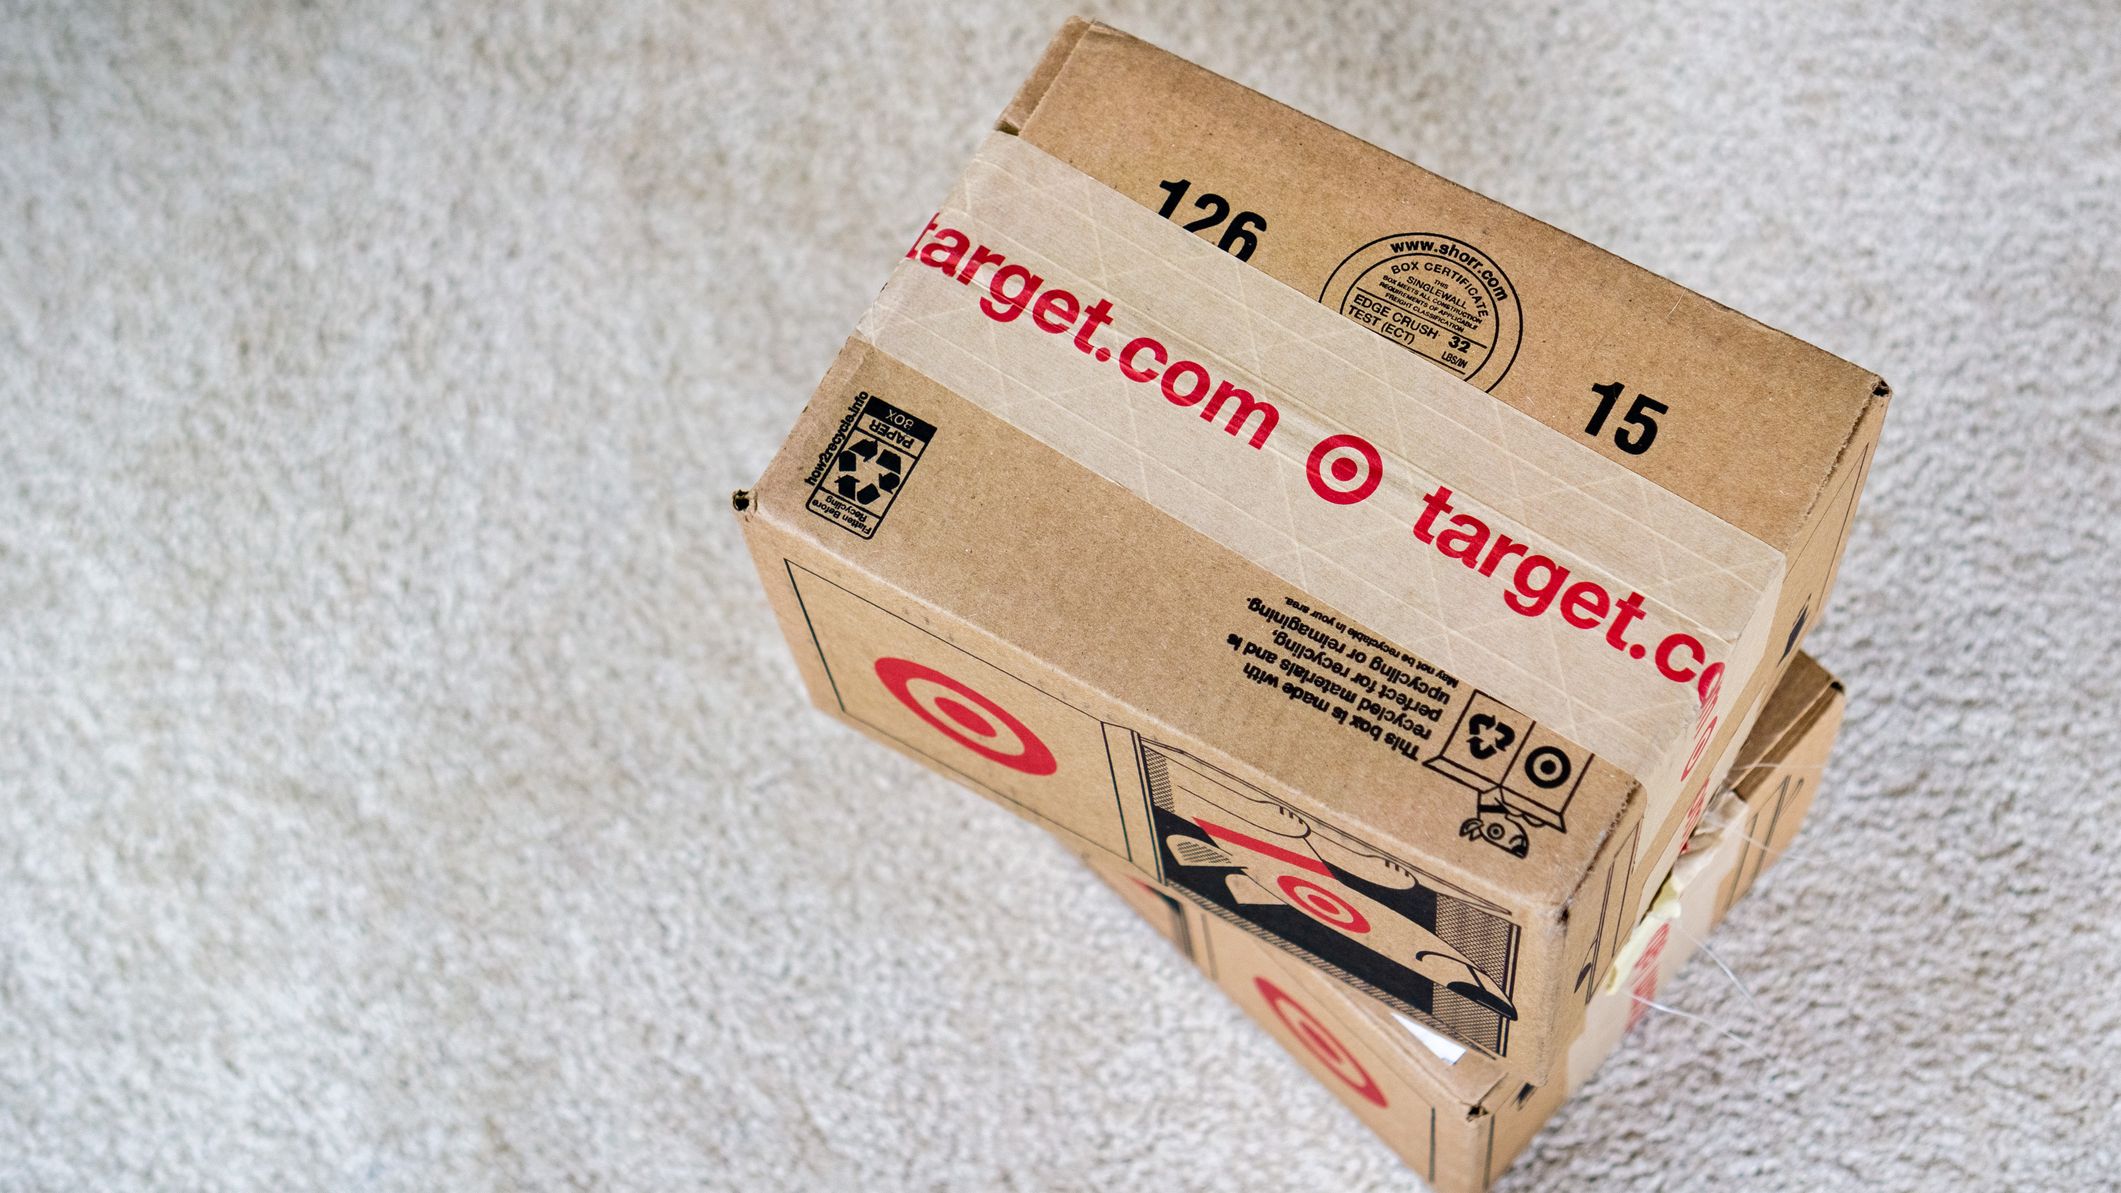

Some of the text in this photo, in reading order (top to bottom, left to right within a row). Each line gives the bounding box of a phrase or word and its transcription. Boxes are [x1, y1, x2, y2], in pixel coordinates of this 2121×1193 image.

[1158, 179, 1267, 262] 126
[1390, 240, 1508, 302] www.shorr.com
[1391, 261, 1489, 318] BOX CERTIFICATE
[1406, 276, 1467, 310] SINGLEWALL
[1434, 279, 1449, 289] THIS
[1353, 294, 1439, 340] EDGE CRUSH
[1379, 282, 1478, 331] REQUIREMENTS OF APPLICABLE
[1382, 275, 1483, 324] BOX MEETS ALL CONSTRUCTION
[1385, 292, 1465, 333] FREIGHT CLASSIFICATION
[1348, 304, 1415, 345] TEST (ECT)
[1448, 336, 1471, 354] 32
[804, 391, 869, 487] how2recycle.info
[868, 419, 915, 449] PAPER
[885, 409, 914, 430] BOX
[1584, 381, 1669, 455] 15
[812, 498, 872, 535] Flatten Before
[825, 495, 868, 523] Recycling
[1247, 597, 1451, 705] upcycling or reimagining.
[1285, 596, 1459, 688] May not be recyclable in your area.
[1227, 634, 1432, 740] recycled materials and is
[1272, 630, 1443, 722] perfect for recycling,
[1243, 663, 1420, 761] This box is made with
